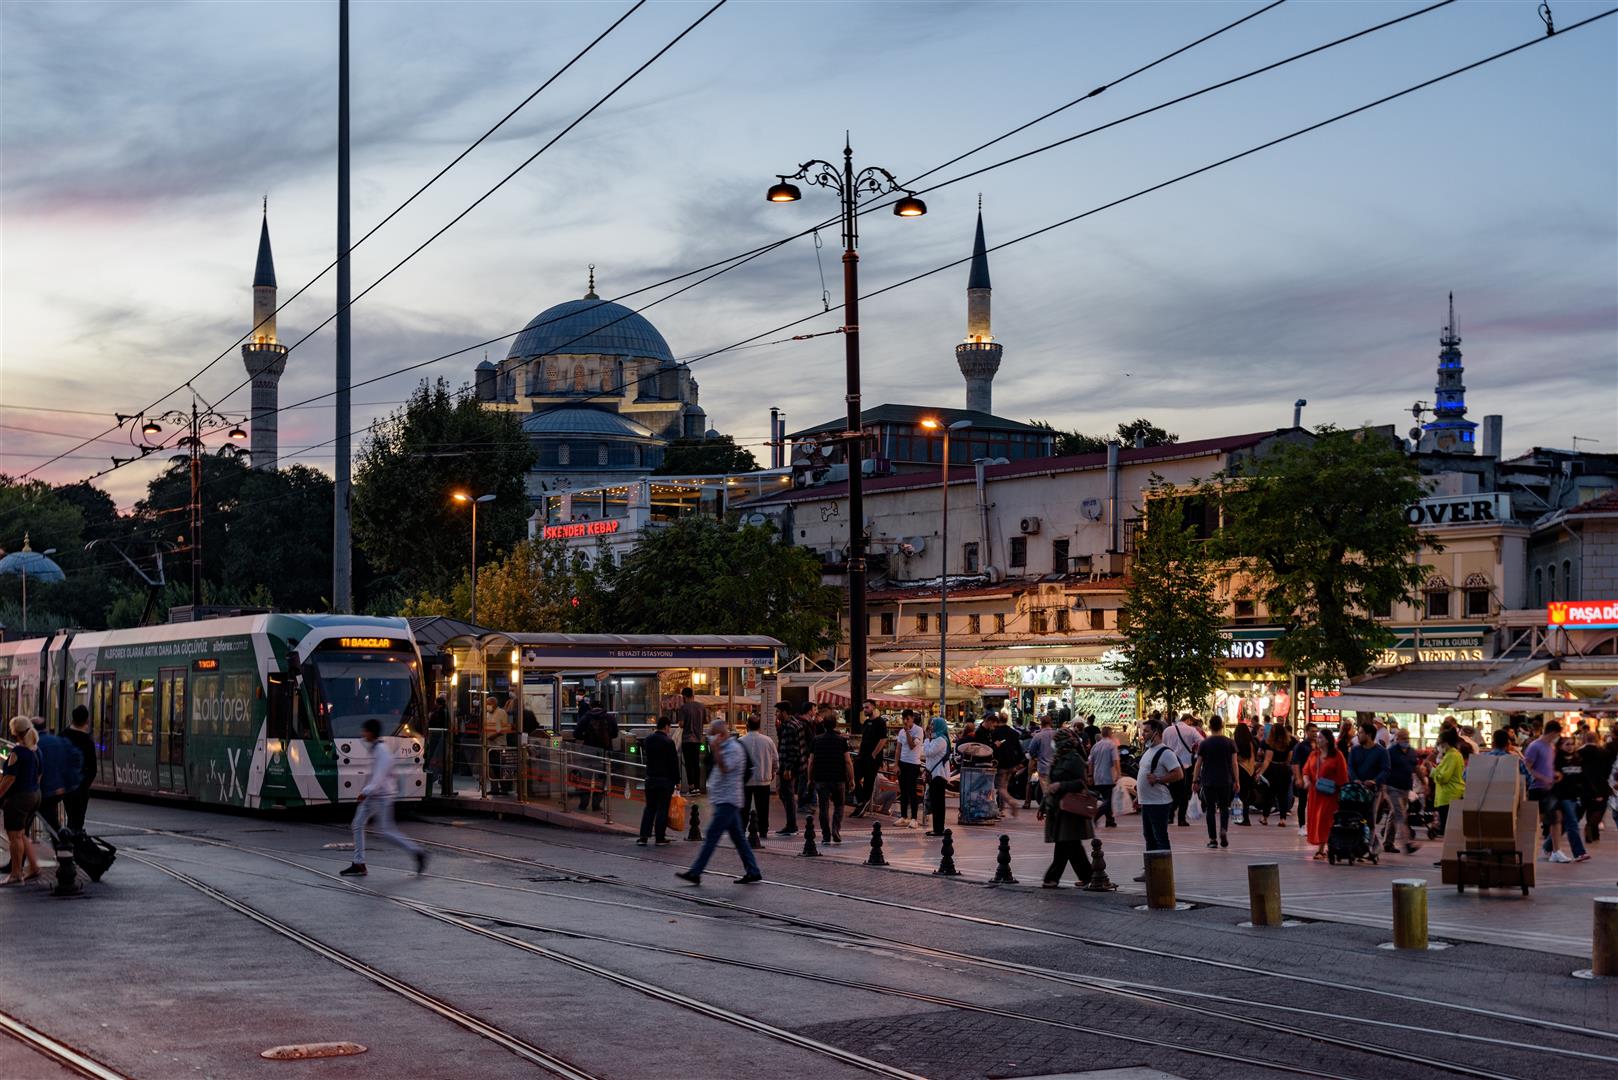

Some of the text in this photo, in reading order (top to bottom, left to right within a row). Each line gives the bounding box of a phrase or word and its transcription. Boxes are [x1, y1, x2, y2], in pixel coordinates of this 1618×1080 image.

[544, 519, 618, 539] İSKENDER KEBAP
[1569, 606, 1603, 623] PAŞA
[201, 691, 251, 722] albforex
[1297, 691, 1306, 742] CHANG
[121, 762, 153, 787] albforex
